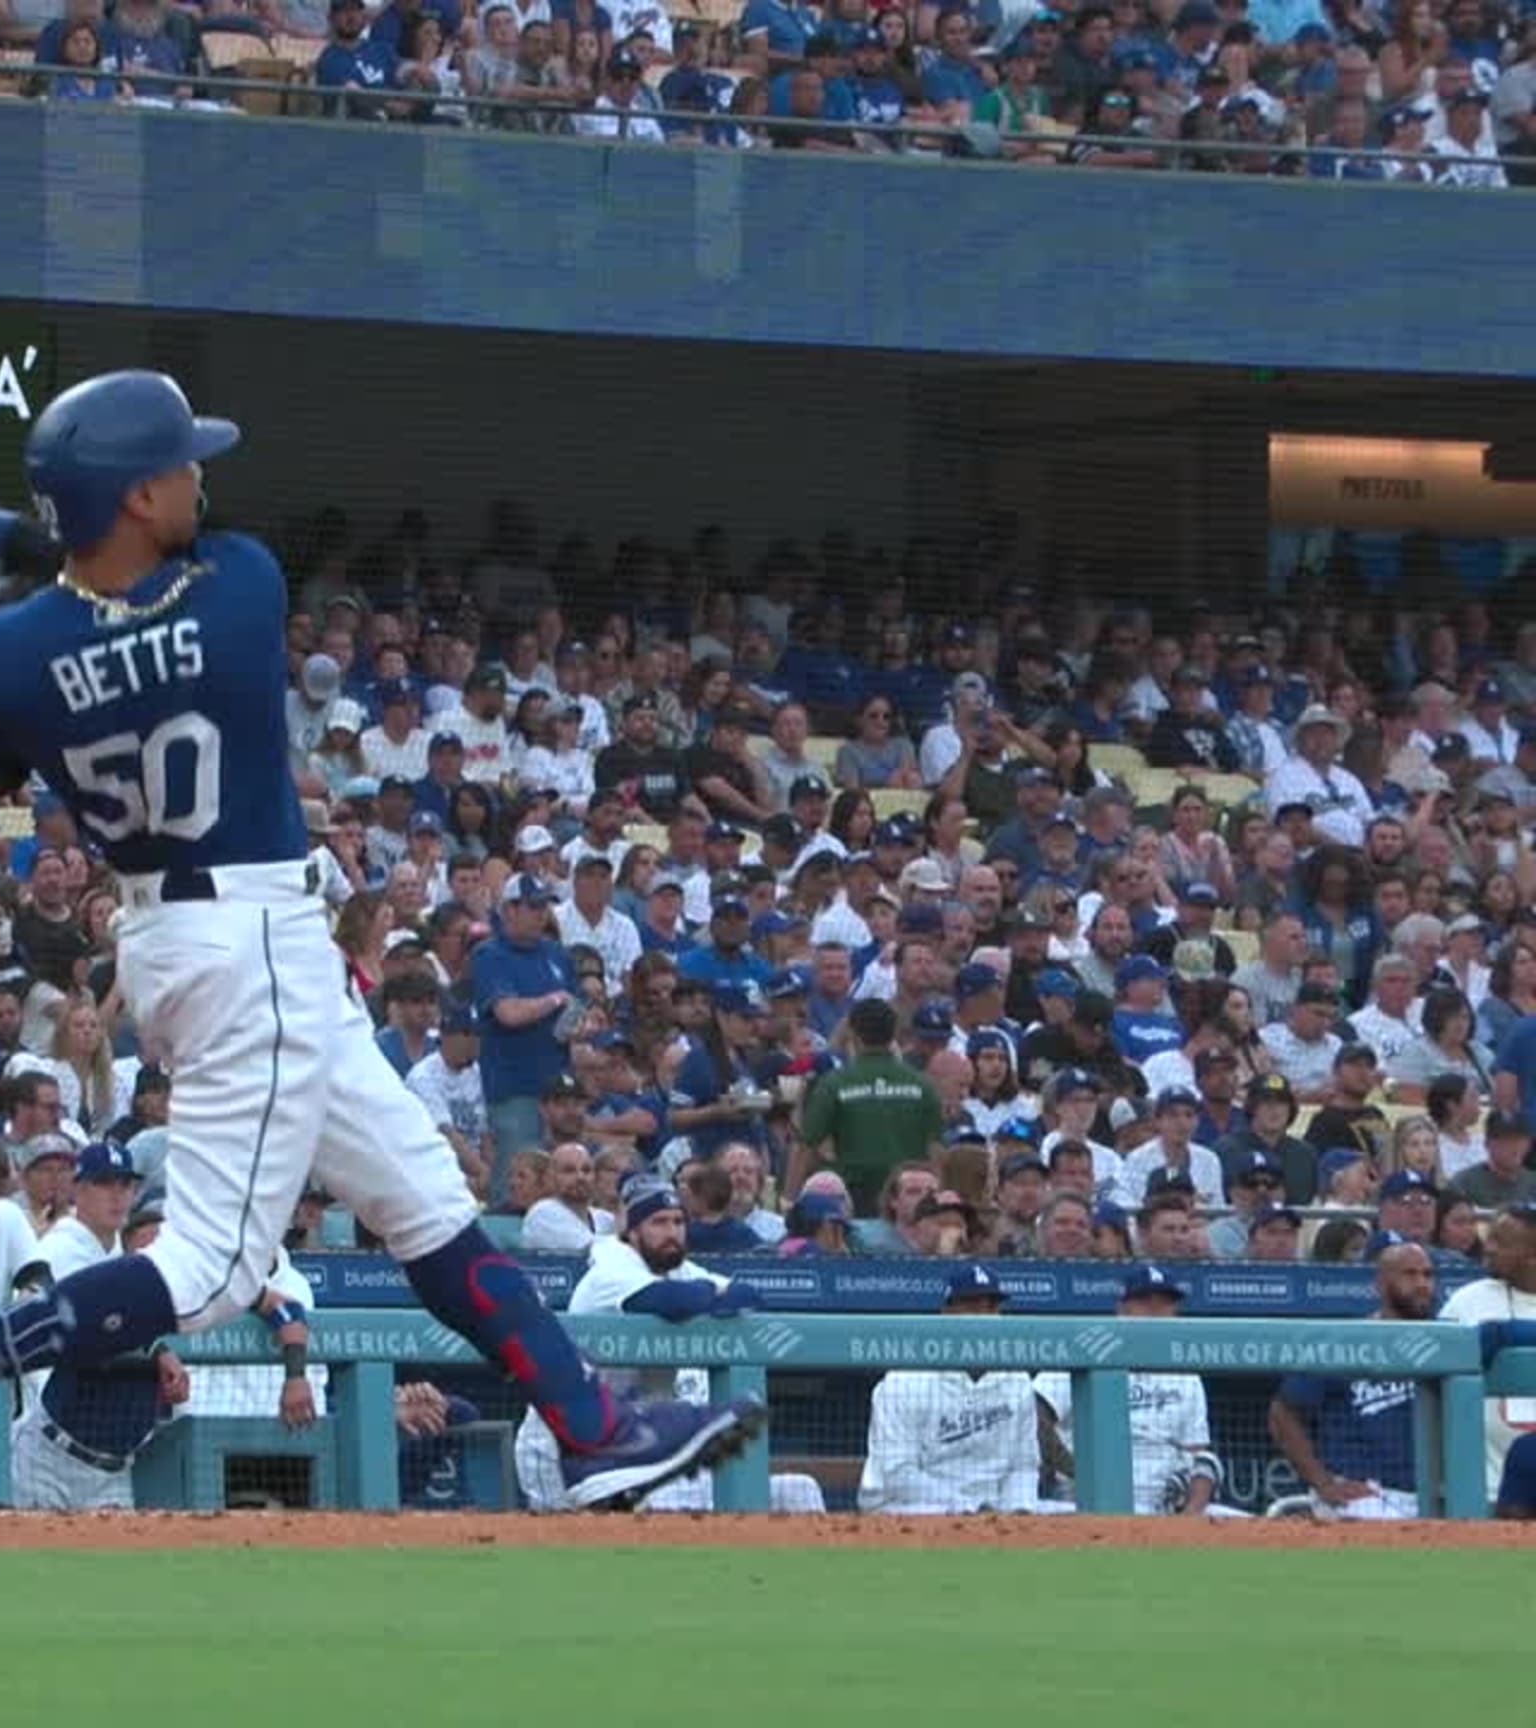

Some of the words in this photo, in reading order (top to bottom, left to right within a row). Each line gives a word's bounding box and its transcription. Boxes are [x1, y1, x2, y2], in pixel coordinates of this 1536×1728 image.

[51, 618, 204, 713] BETTS
[64, 711, 221, 842] 50
[190, 1330, 260, 1353] BANK
[307, 1331, 420, 1354] AMERICA
[598, 1335, 629, 1358] OF
[635, 1335, 749, 1359] AMERICA
[850, 1338, 917, 1361] BANK
[923, 1338, 954, 1361] OF
[959, 1339, 1070, 1363] AMERICA
[1170, 1342, 1240, 1364] BANK
[1242, 1342, 1273, 1364] OF
[1279, 1342, 1389, 1366] AMERICA
